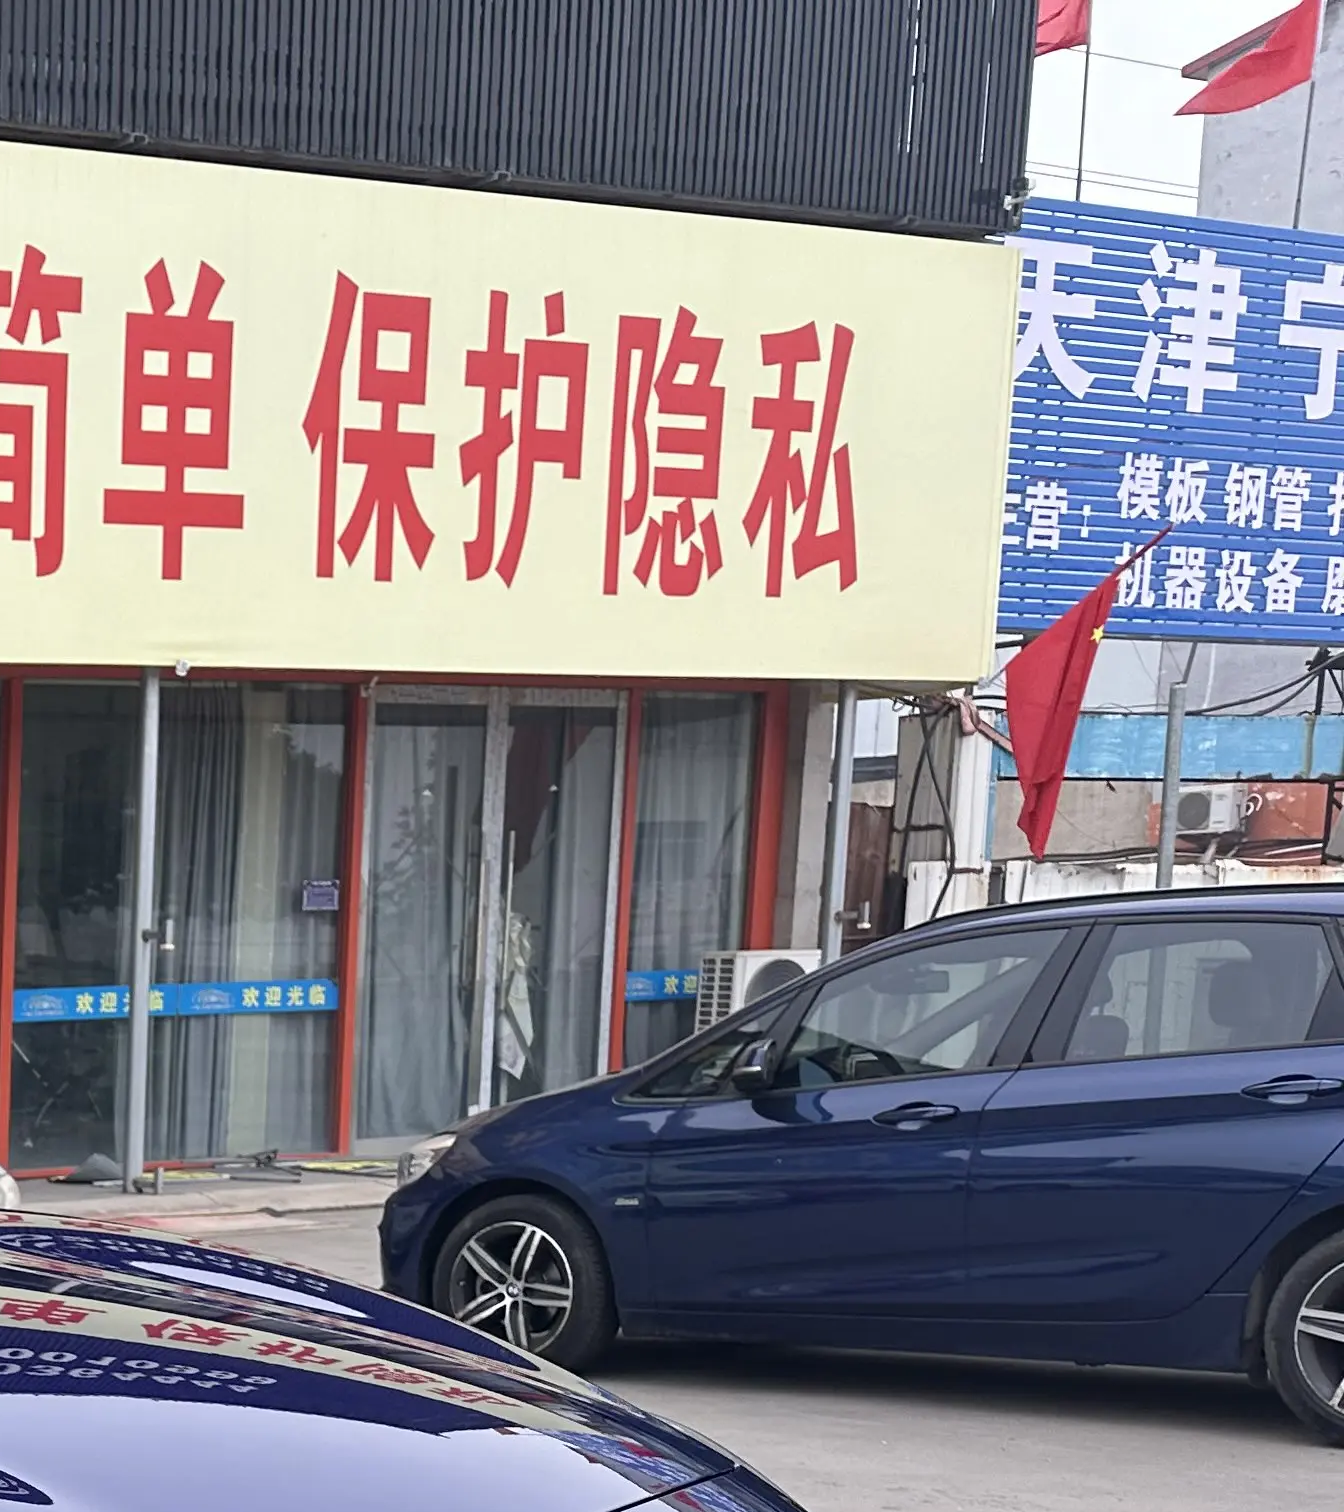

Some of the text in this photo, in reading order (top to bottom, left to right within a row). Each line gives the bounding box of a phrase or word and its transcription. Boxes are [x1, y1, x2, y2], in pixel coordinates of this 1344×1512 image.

[302, 269, 857, 597] 保护隐私
[1116, 451, 1209, 525] 模板
[1223, 462, 1312, 532] 钢管
[1114, 541, 1304, 613] 机器设备
[241, 984, 327, 1008] 欢迎光临
